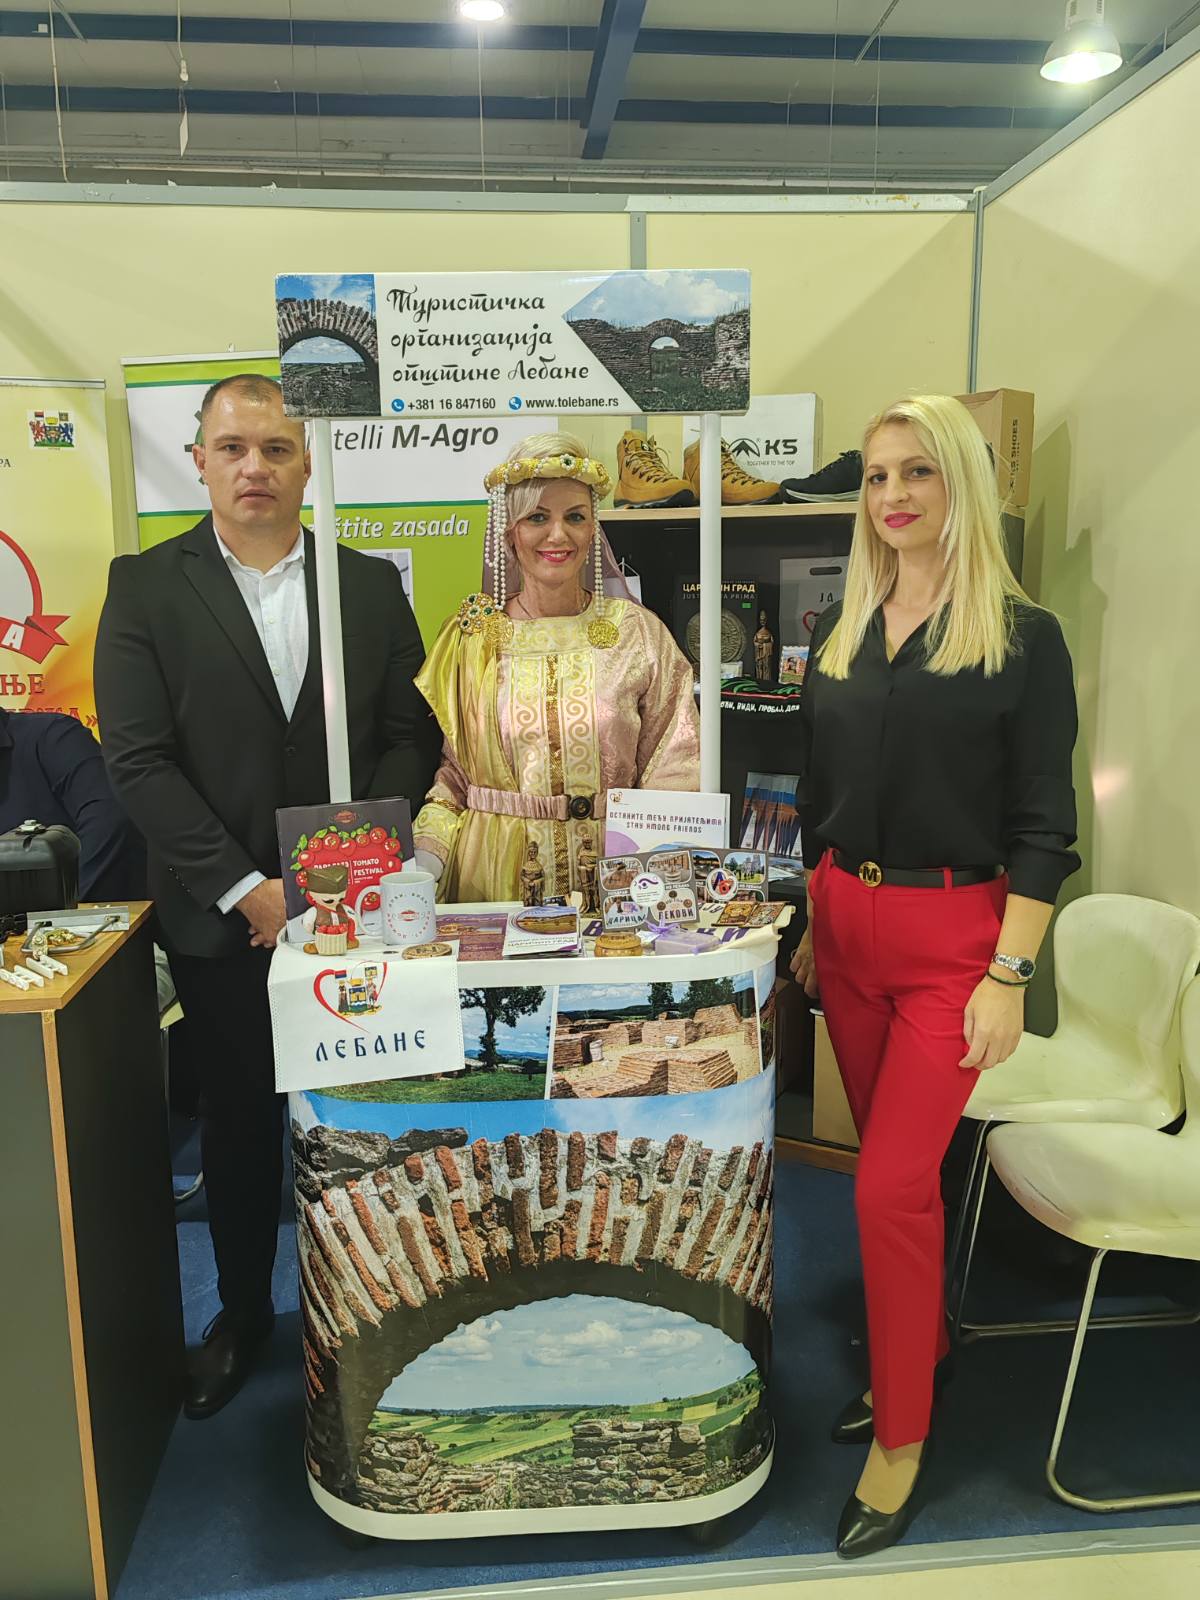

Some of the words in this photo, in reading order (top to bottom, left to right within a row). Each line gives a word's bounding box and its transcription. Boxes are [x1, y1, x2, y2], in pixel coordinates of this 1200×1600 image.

[387, 285, 545, 323] Туристичка
[391, 323, 553, 358] организација
[392, 363, 501, 386] општине
[507, 354, 589, 381] Лебане
[407, 398, 435, 410] +381
[439, 398, 453, 410] 16
[455, 398, 496, 410] 847160
[525, 396, 619, 409] www.tolebane.rs
[333, 424, 384, 451] telli
[391, 423, 499, 453] M-Agro
[764, 439, 798, 455] KS
[390, 513, 470, 538] zasada
[731, 583, 756, 593] ГРАД
[609, 811, 644, 821] ОСТАНИТЕ
[626, 821, 643, 829] STAY
[646, 823, 670, 832] AMONG
[673, 825, 702, 834] FRIENDS
[352, 858, 380, 867] TOMATO
[353, 867, 384, 876] FESTIVAL
[315, 1030, 426, 1062] ЛЕБАНЕ
